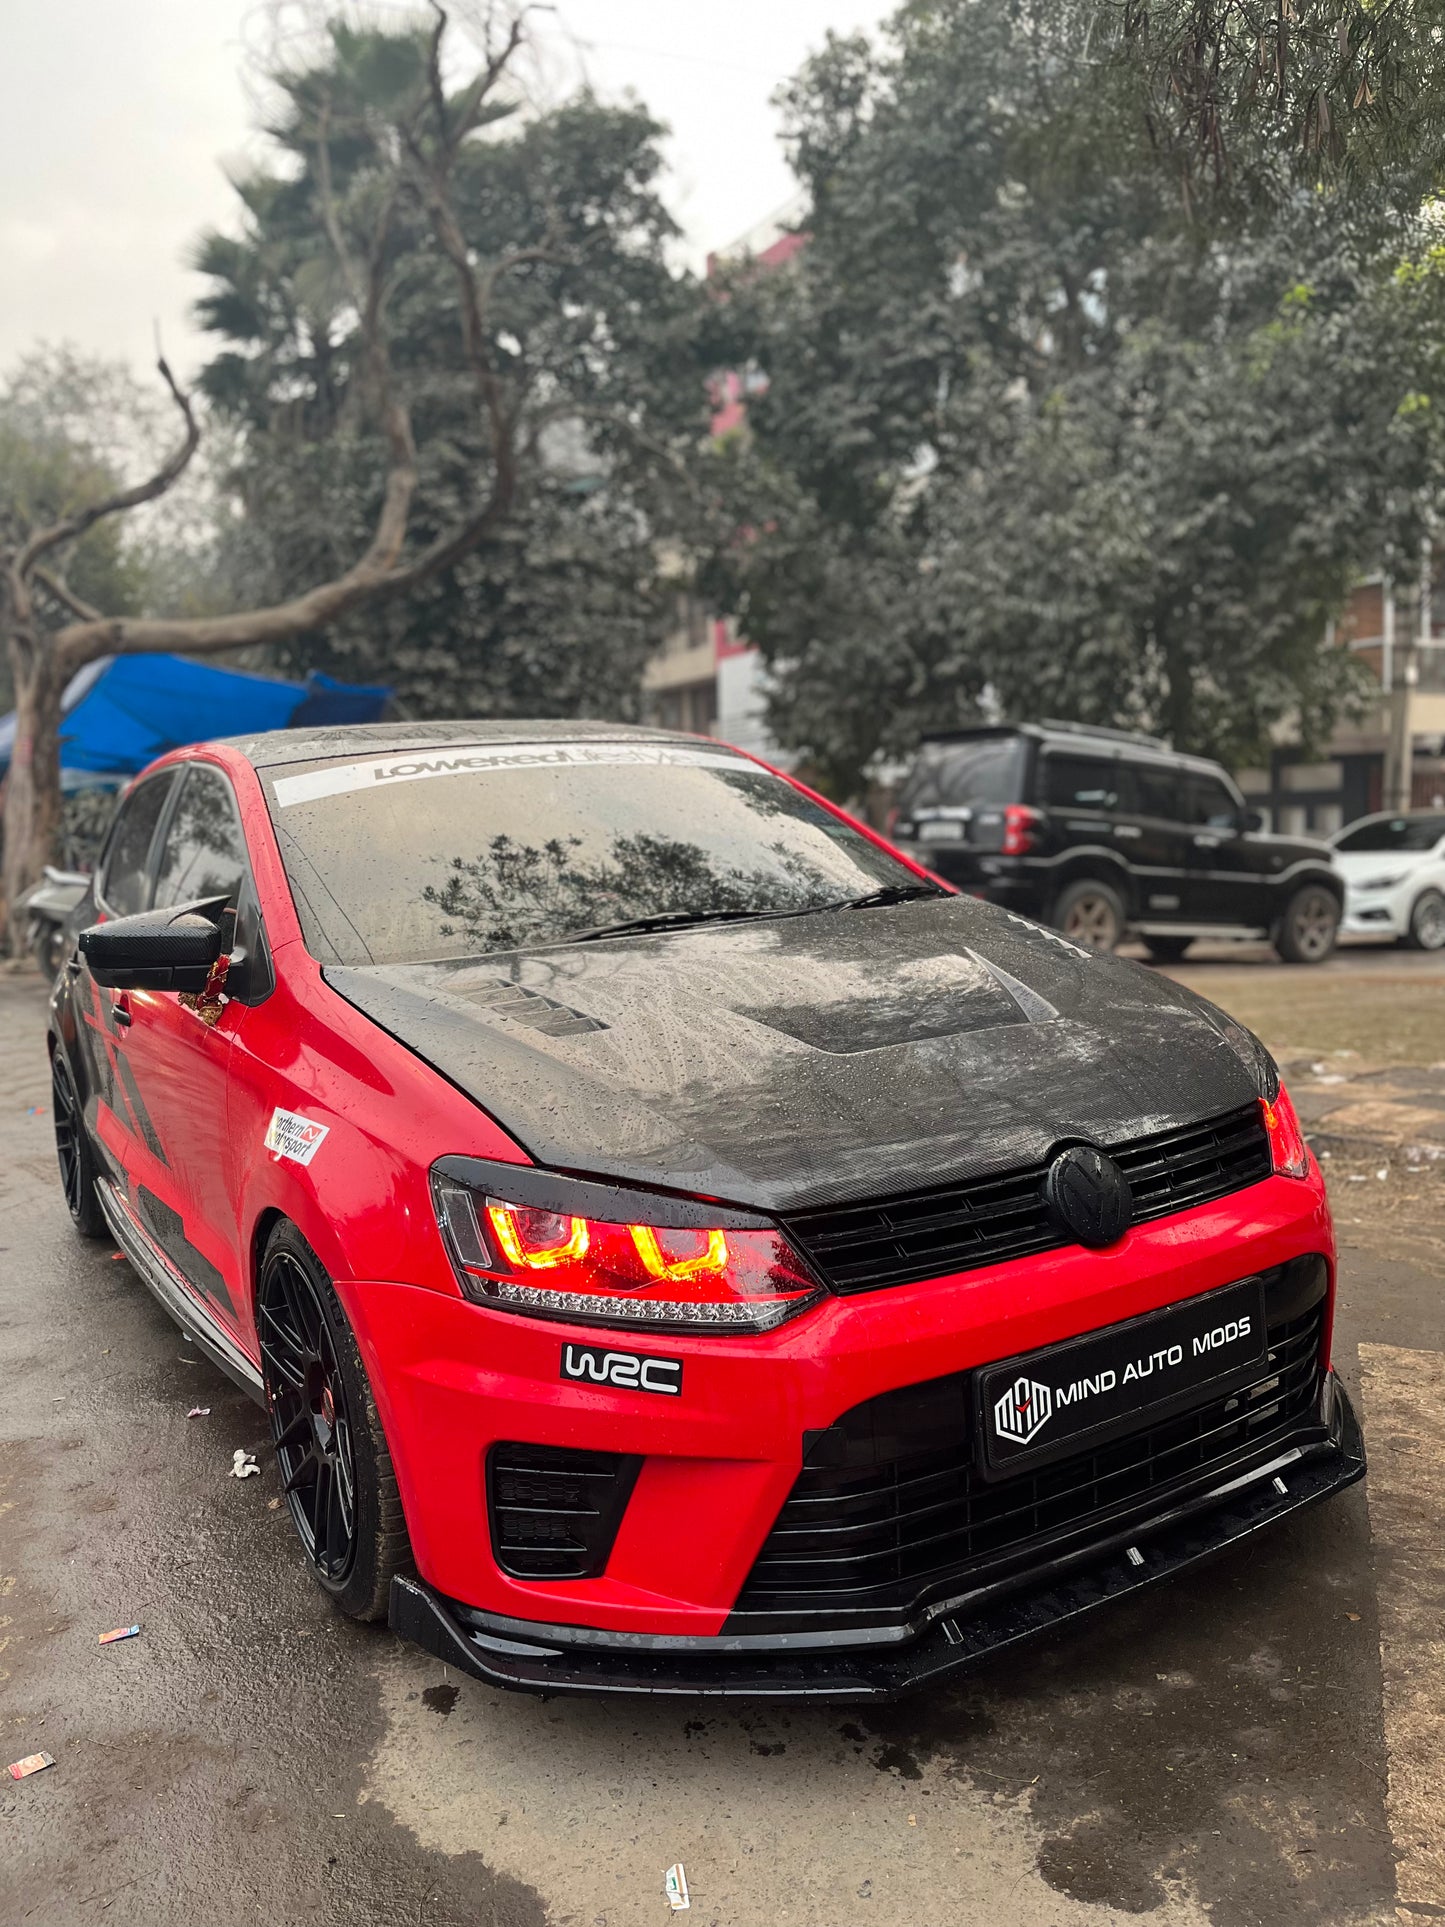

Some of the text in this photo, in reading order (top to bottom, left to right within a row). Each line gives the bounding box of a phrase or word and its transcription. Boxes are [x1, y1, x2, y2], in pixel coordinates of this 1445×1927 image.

[272, 1115, 306, 1138] orthern
[565, 1345, 680, 1393] WRC
[1055, 1316, 1251, 1408] MIND AUTO MODS
